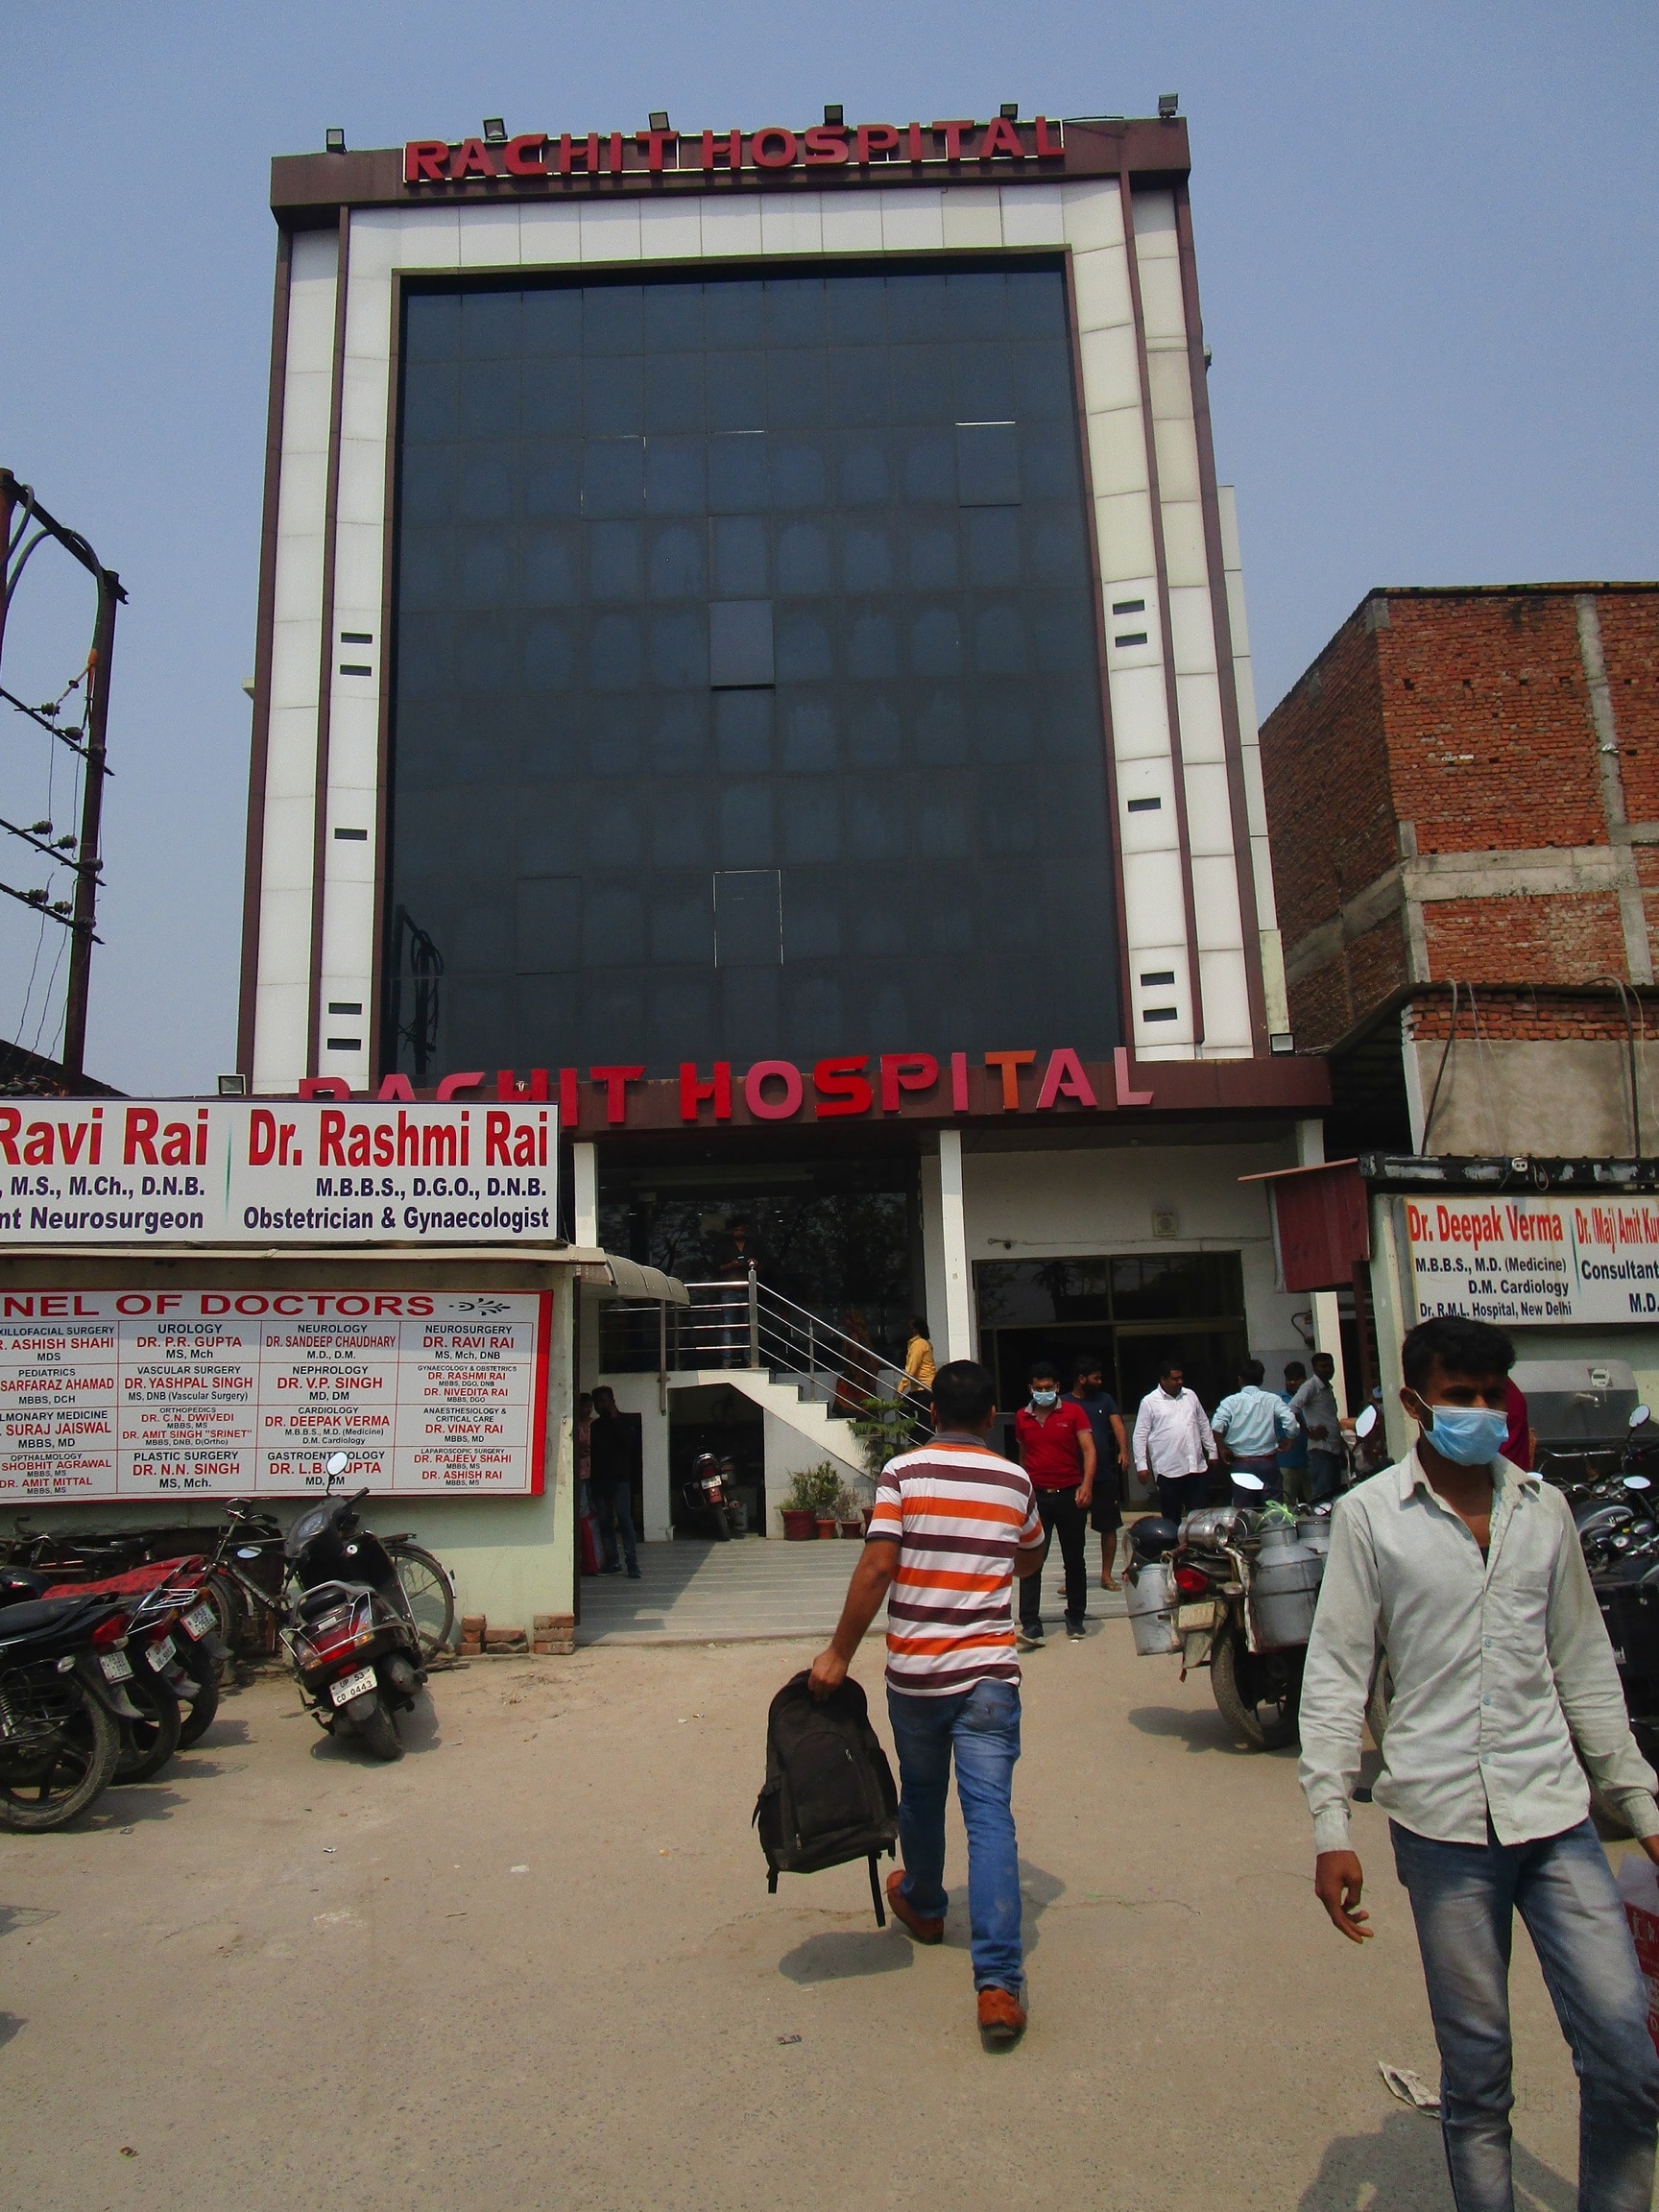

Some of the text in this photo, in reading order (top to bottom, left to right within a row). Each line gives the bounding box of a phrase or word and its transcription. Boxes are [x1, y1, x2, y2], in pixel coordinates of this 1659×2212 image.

[404, 115, 1066, 182] RACHIT HOSPITAL
[680, 1046, 1153, 1121] HOSPITAL
[0, 1107, 208, 1166] Ravi Rai
[249, 1109, 548, 1166] Dr. Rashmi Rai
[11, 1176, 205, 1199] M.S., M.Ch., D.N.B.
[316, 1178, 547, 1200] M.B.B.S., D.G.O., D.N.B.
[30, 1207, 204, 1235] Neurosurgeon
[243, 1207, 549, 1234] Obstetrician & Gynaecologist
[1407, 1205, 1563, 1251] Dr. Deepak Verma
[1575, 1208, 1592, 1244] Dr.
[1592, 1207, 1617, 1254] (Maj)
[1618, 1208, 1643, 1244] Amit
[1415, 1257, 1567, 1275] M.B.B.S., M.D. (Medicine)
[1581, 1260, 1659, 1280] Consultant
[1468, 1279, 1569, 1296] D.M. Cardiology
[4, 1294, 434, 1317] NEL OF DOCTORS
[1420, 1301, 1572, 1319] Dr. R.M.L. Hospital, New Delhi
[66, 1327, 114, 1335] SURGERY
[157, 1324, 223, 1334] UROLOGY
[298, 1324, 368, 1333] NEUROLOGY
[425, 1325, 513, 1334] NEUROSURGERY
[12, 1338, 66, 1350] ASHISH
[70, 1337, 113, 1348] SHAHI
[136, 1336, 242, 1348] DR. P.R. GUPTA
[266, 1335, 396, 1348] DR. SANDEEP CHAUDHARY
[422, 1336, 515, 1349] DR. RAVI RAI
[166, 1350, 213, 1359] MS, Mch
[435, 1351, 452, 1359] MS,
[455, 1352, 477, 1360] Mch,
[292, 1366, 369, 1375] NEPHROLOGY
[447, 1372, 487, 1381] RASHMI
[0, 1378, 114, 1391] SARFARAZ AHAMAD
[124, 1377, 252, 1389] DR. YASHPAL SINGH
[276, 1378, 382, 1389] DR. V.P. SINGH
[128, 1391, 248, 1402] MS, DNB (Vascular Surgery)
[309, 1391, 349, 1401] MD, DM
[491, 1388, 509, 1397] RAI
[18, 1395, 76, 1405] MBBS, DCH
[57, 1410, 108, 1420] MEDICINE
[265, 1415, 390, 1427] DR. DEEPAK VERMA
[6, 1422, 111, 1436] SURAJ JAISWAL
[142, 1431, 167, 1439] AMIT
[205, 1430, 252, 1438] "SRINET"
[425, 1425, 503, 1433] DR. VINAY RAI
[18, 1438, 75, 1449] MBBS, MD
[322, 1436, 366, 1445] Cardiology
[11, 1453, 83, 1461] OPTHALMOLOGY
[133, 1451, 238, 1461] PLASTIC SURGERY
[268, 1451, 385, 1460] GASTROENTOLOGY
[414, 1455, 512, 1463] DR. RAJEEV SHAHI
[1, 1459, 111, 1471] SHOBHIT AGRAWAL
[132, 1463, 240, 1476] DR. N.N. SINGH
[270, 1462, 294, 1475] DR.
[342, 1462, 381, 1474] UPTA
[421, 1471, 441, 1479] DR.
[22, 1479, 49, 1487] AMIT
[53, 1478, 92, 1487] MITTAL
[159, 1479, 212, 1489] MS, Mch.
[305, 1477, 325, 1486] MD,
